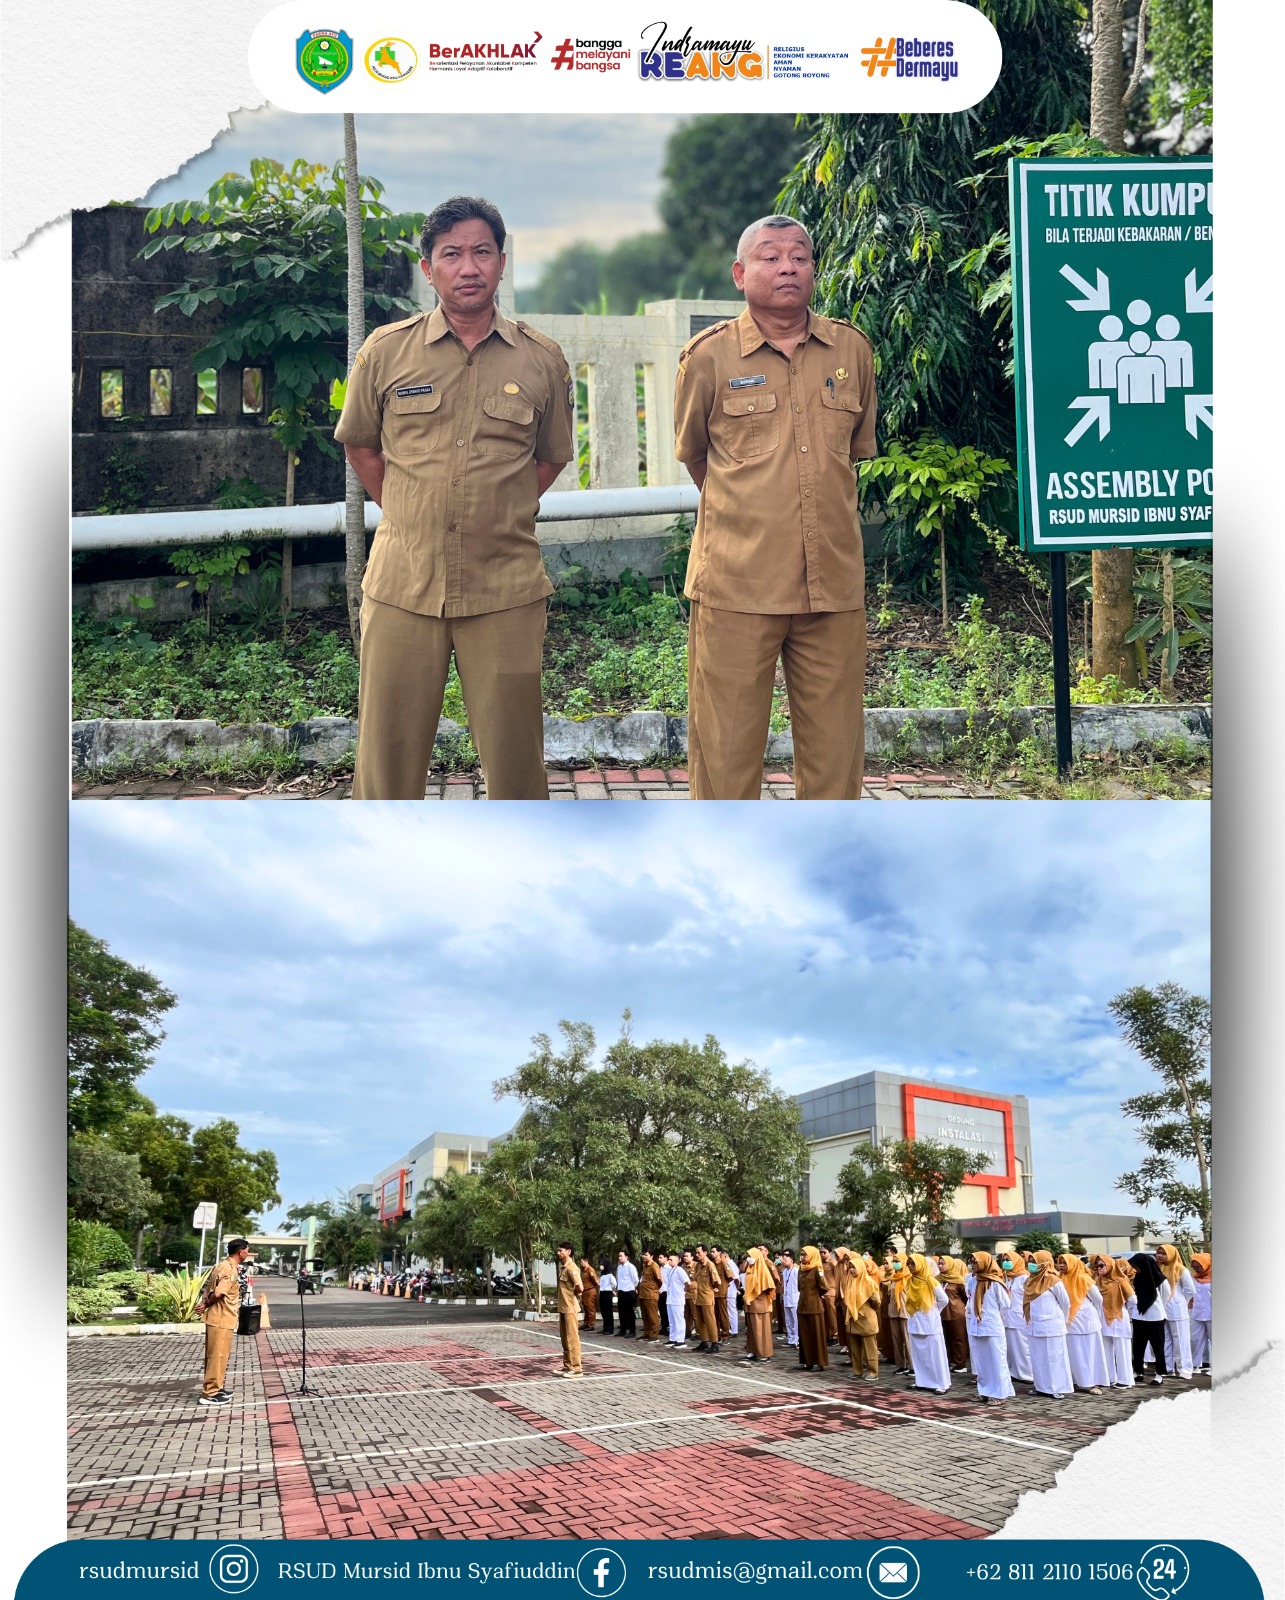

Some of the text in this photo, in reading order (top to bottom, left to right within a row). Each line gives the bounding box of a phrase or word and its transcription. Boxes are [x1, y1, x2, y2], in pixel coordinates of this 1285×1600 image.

[1044, 184, 1114, 217] TITIK
[1045, 228, 1070, 243] BILA
[1073, 227, 1116, 243] TERJADI
[1118, 226, 1182, 242] KEBAKARAN
[1046, 469, 1179, 500] ASSEMBLY
[1049, 509, 1085, 525] RSUD
[1088, 507, 1141, 524] MURSID
[1144, 506, 1176, 522] IBNU
[947, 1115, 975, 1126] GEDUNG
[938, 1127, 984, 1143] INSTALASI
